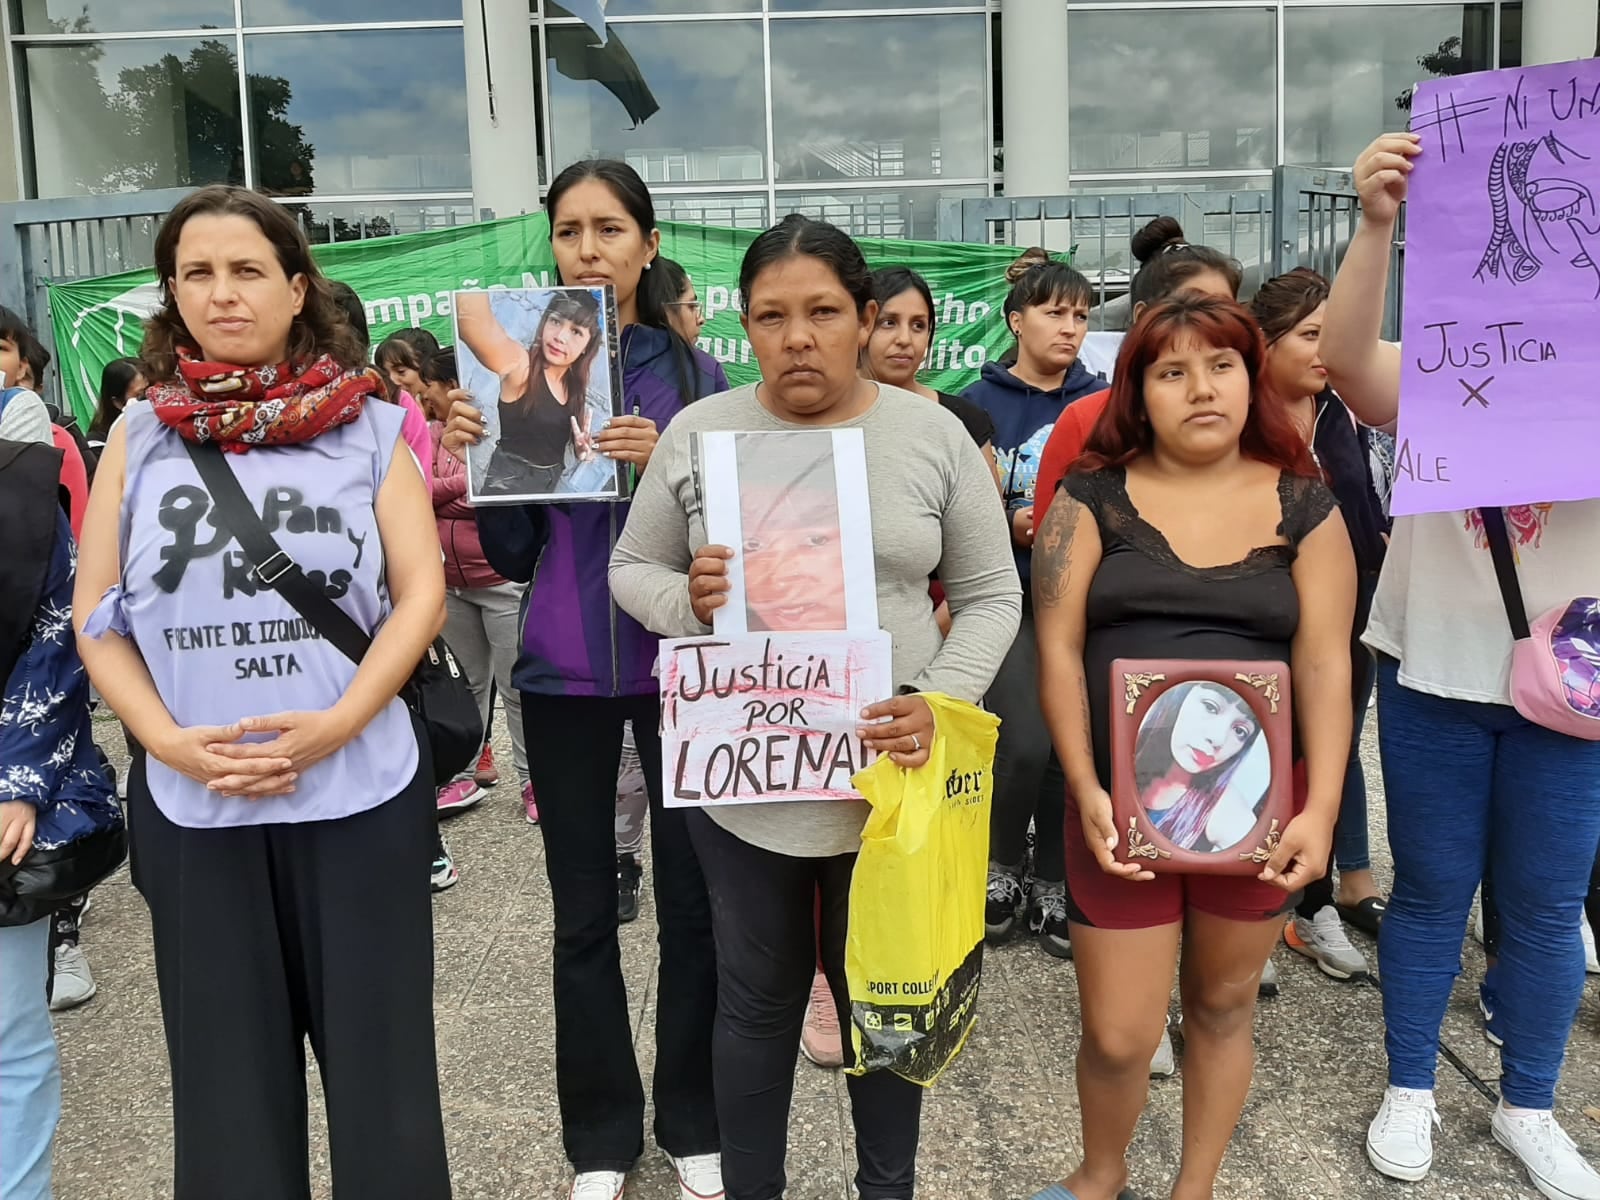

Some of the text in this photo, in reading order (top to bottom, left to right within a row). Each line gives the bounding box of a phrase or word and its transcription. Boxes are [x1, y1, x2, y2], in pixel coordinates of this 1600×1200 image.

[231, 621, 256, 647] DE
[234, 653, 304, 680] SALTA
[742, 697, 809, 732] POR
